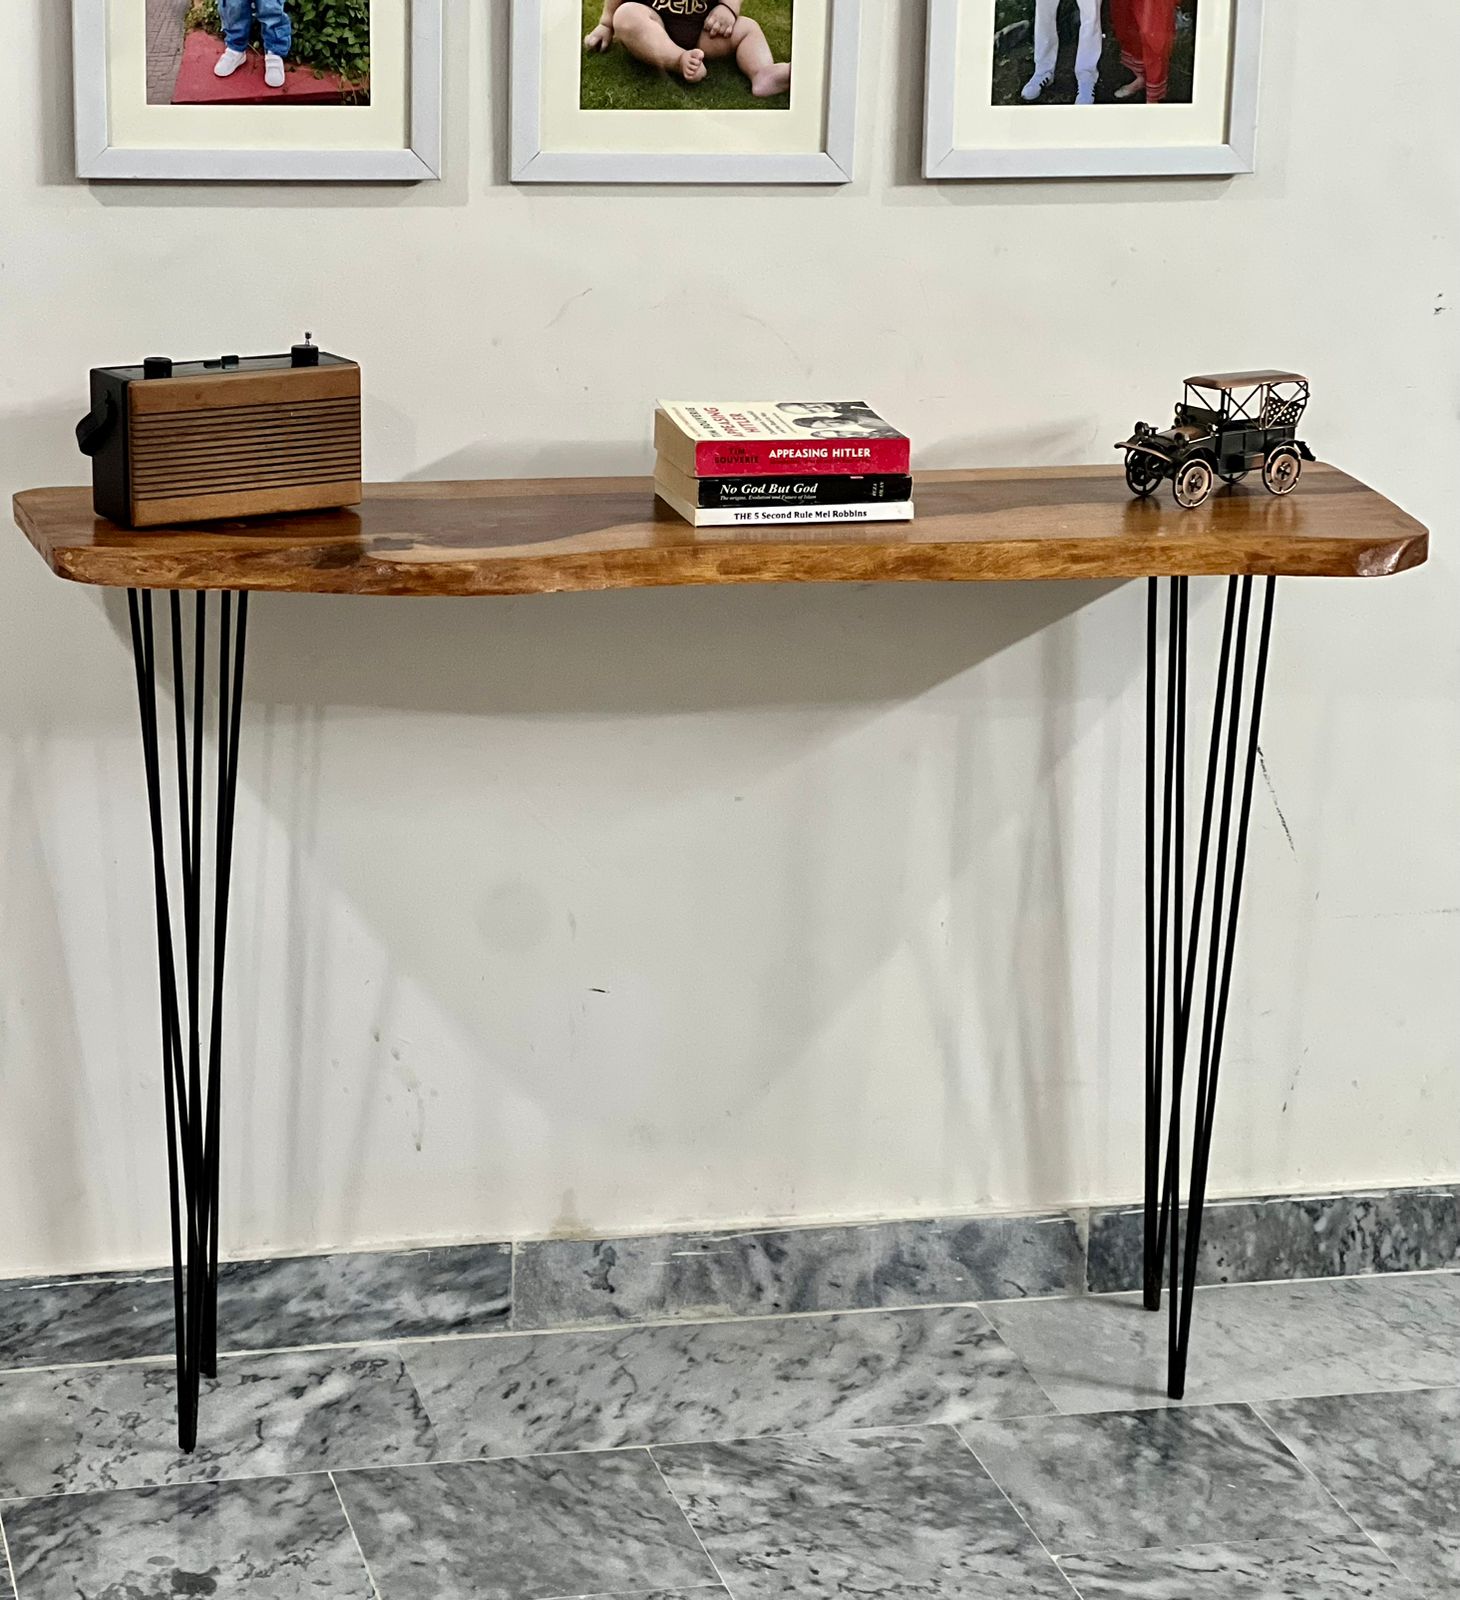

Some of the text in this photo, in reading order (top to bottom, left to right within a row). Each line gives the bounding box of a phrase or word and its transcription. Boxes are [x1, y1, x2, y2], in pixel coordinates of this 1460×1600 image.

[703, 407, 745, 437] APPEASING
[729, 413, 761, 433] HITLER
[768, 447, 871, 459] APPEASING HITLER
[720, 483, 818, 494] No God But God
[734, 510, 867, 521] THE 5 Second Rule Mel Robbins
